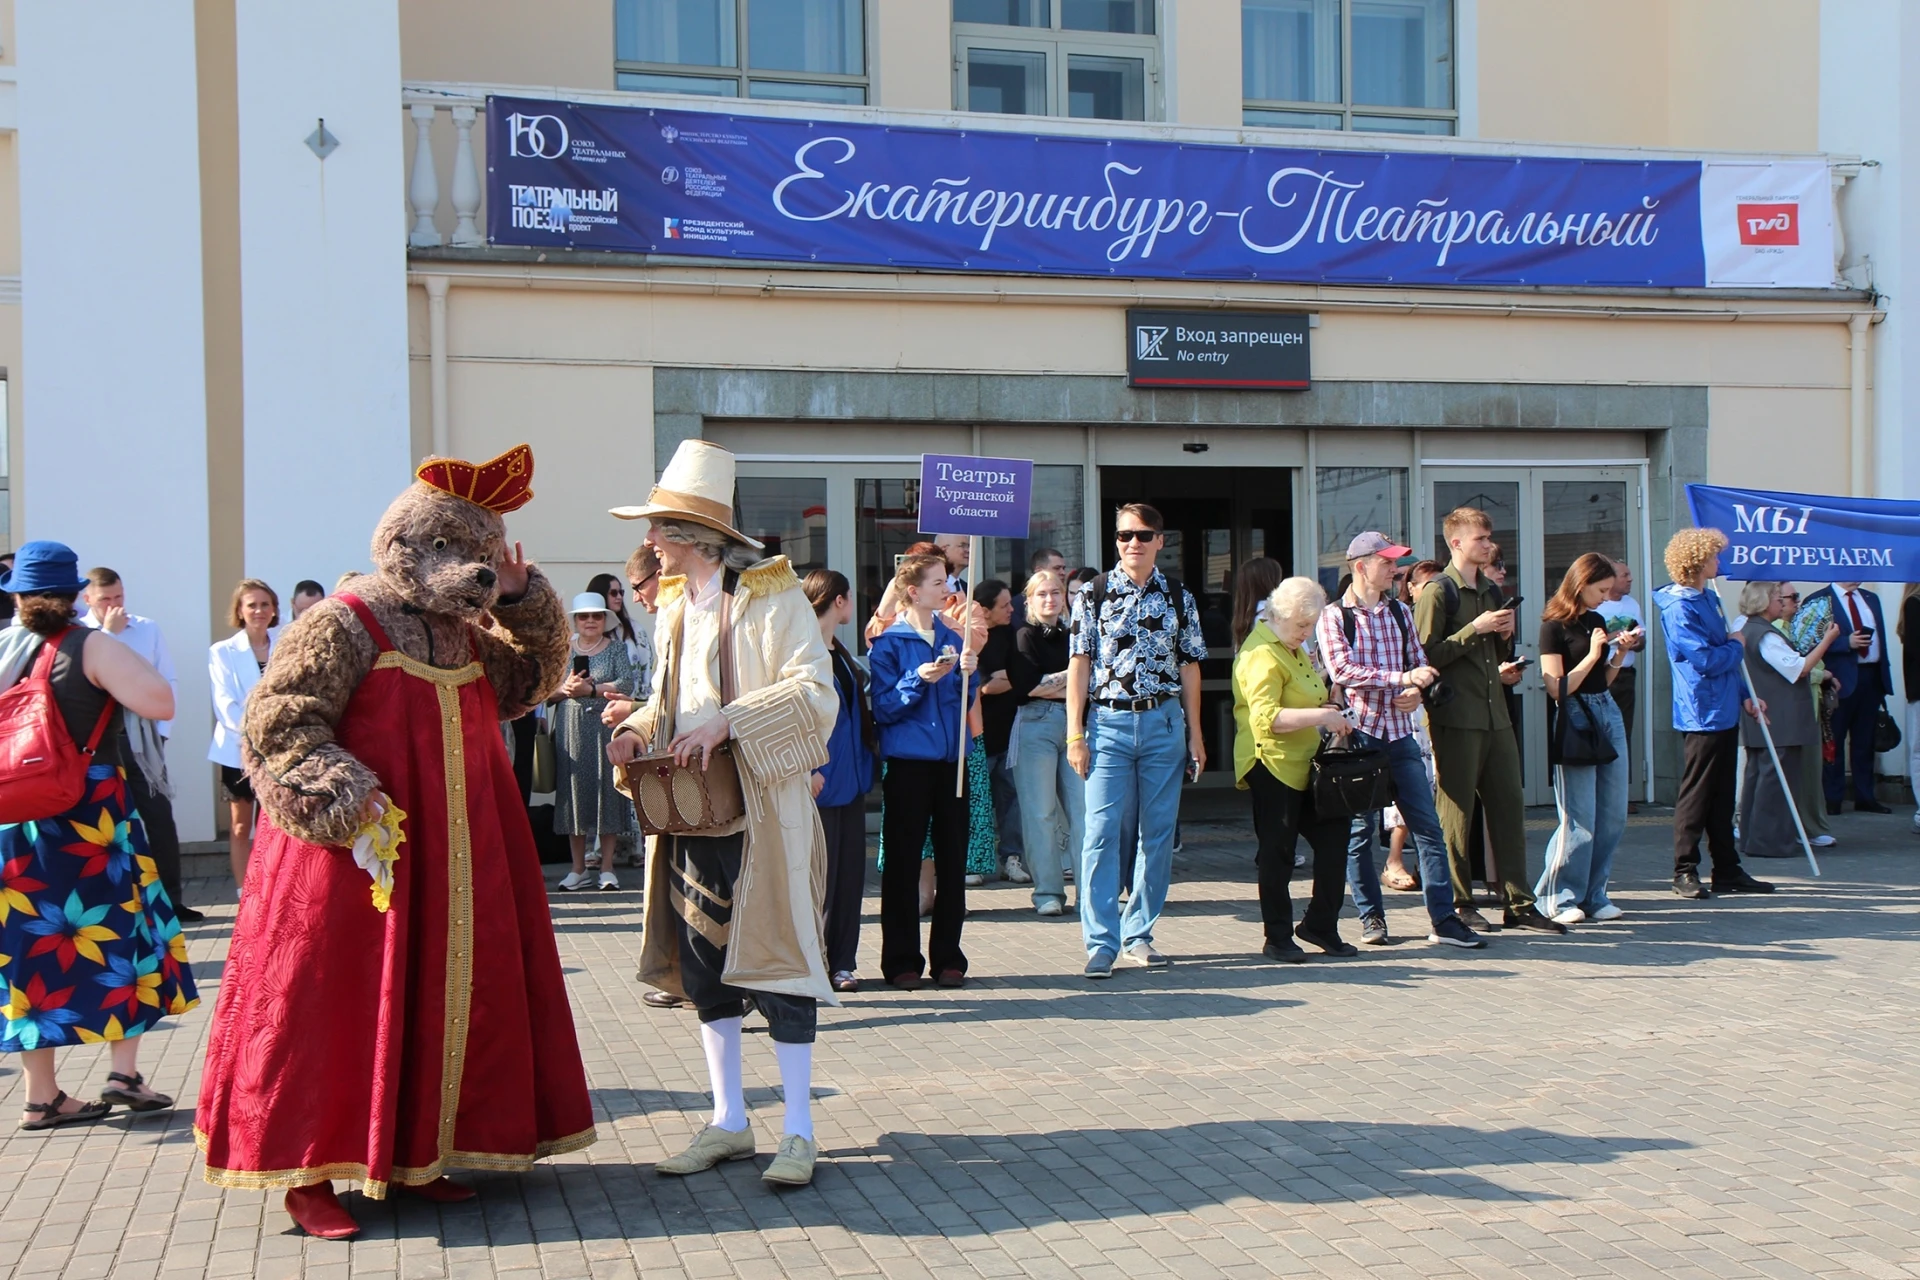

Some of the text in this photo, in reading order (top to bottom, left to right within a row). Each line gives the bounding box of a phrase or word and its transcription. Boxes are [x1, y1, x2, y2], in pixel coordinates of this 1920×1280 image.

[505, 112, 569, 159] 150
[571, 140, 595, 148] СОЮЗ
[572, 147, 626, 158] ТЕАТРАЛЬНЫХ
[509, 184, 618, 212] ТЕАТРАЛЬНЫЙ
[512, 206, 565, 233] ПОЕЗД
[569, 214, 618, 225] всероссийский
[683, 219, 744, 228] ПРЕЗИДЕНТСКИЙ
[569, 223, 591, 232] проект
[683, 226, 754, 236] ФОНД КУЛЬТУРНЫХ
[683, 233, 727, 242] ИНИЦИАТИВ
[1176, 326, 1303, 347] Вход запрещен
[1177, 350, 1229, 365] No entry
[936, 462, 1016, 488] Театры
[935, 486, 1015, 503] Курганской
[949, 505, 998, 518] области
[1732, 504, 1813, 534] МЫ
[1730, 545, 1894, 567] ВСТРЕЧАЕМ
